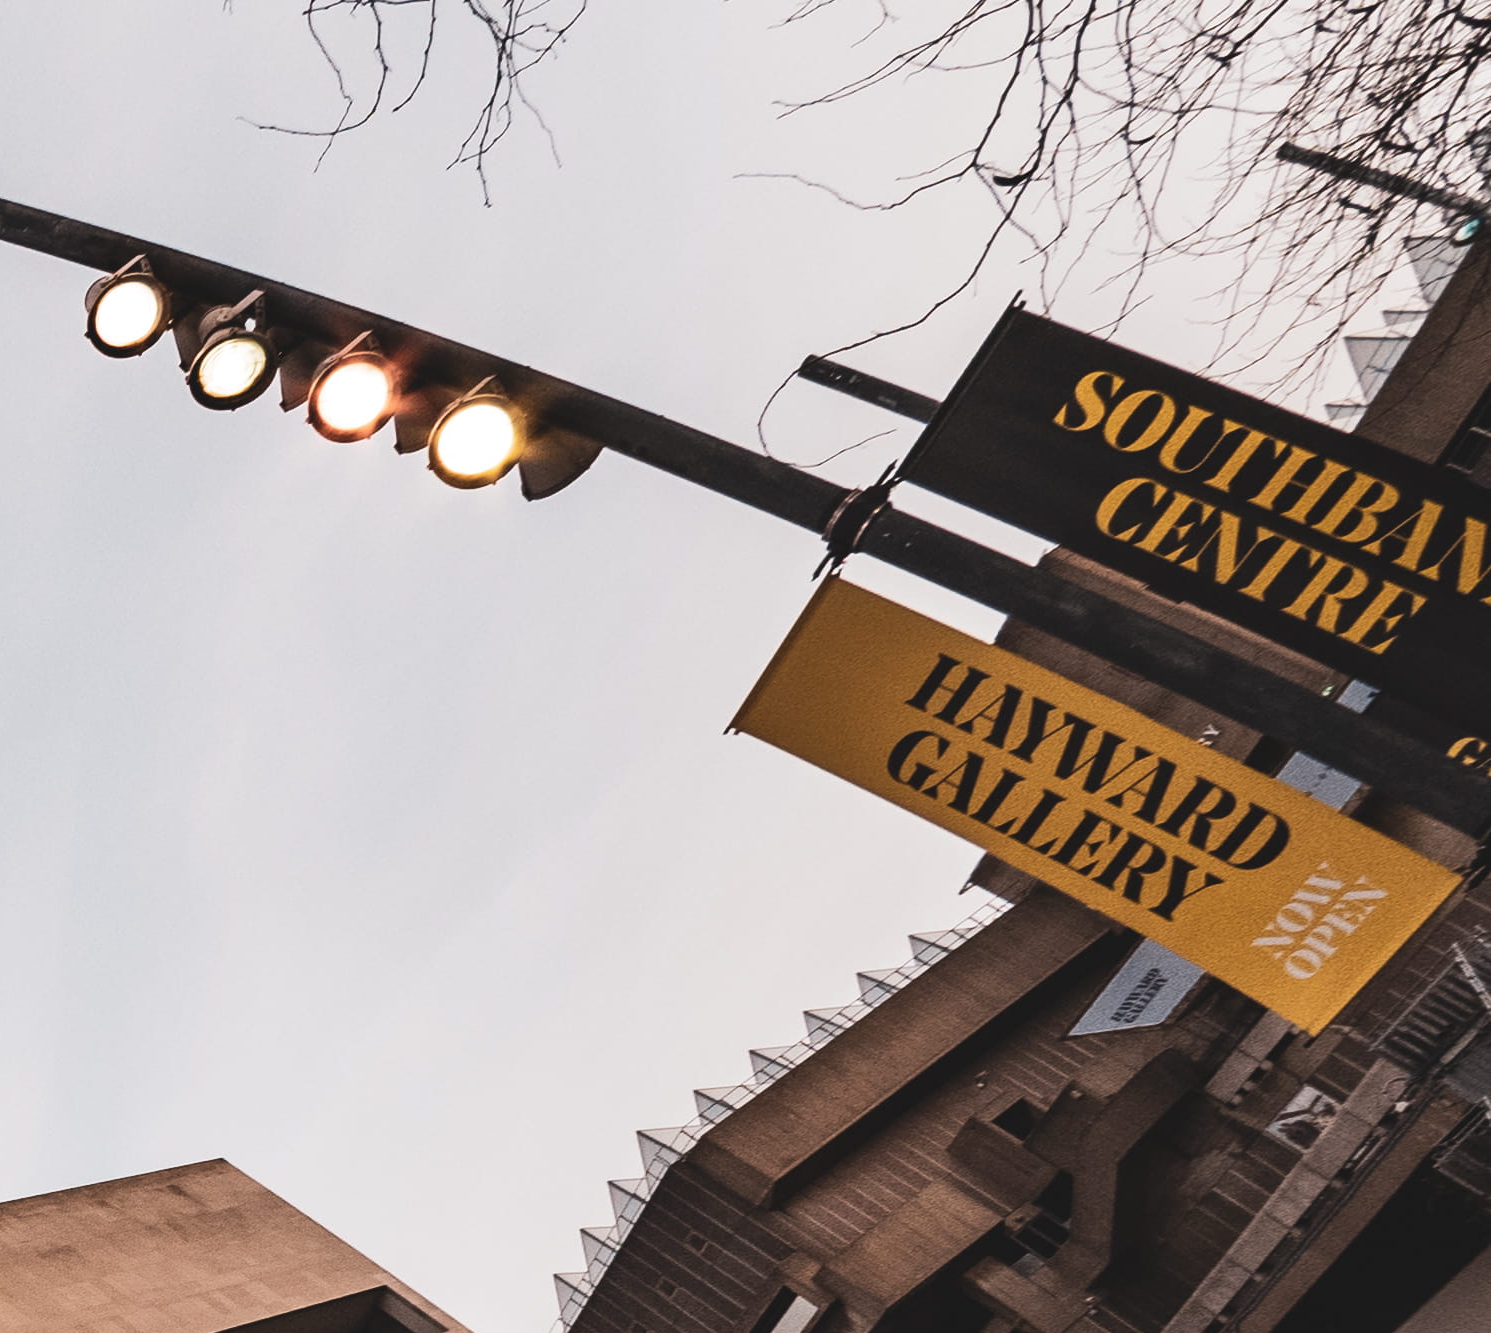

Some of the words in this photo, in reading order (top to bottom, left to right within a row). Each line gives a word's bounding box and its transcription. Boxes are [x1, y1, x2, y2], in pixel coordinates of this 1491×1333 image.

[1053, 369, 1491, 606] SOUTHBAN
[1094, 476, 1428, 655] CENTRE
[886, 729, 1225, 922] GALLERY
[904, 653, 1291, 872] HAYWARD
[1250, 861, 1344, 961] NOW
[1283, 875, 1389, 979] OPEN
